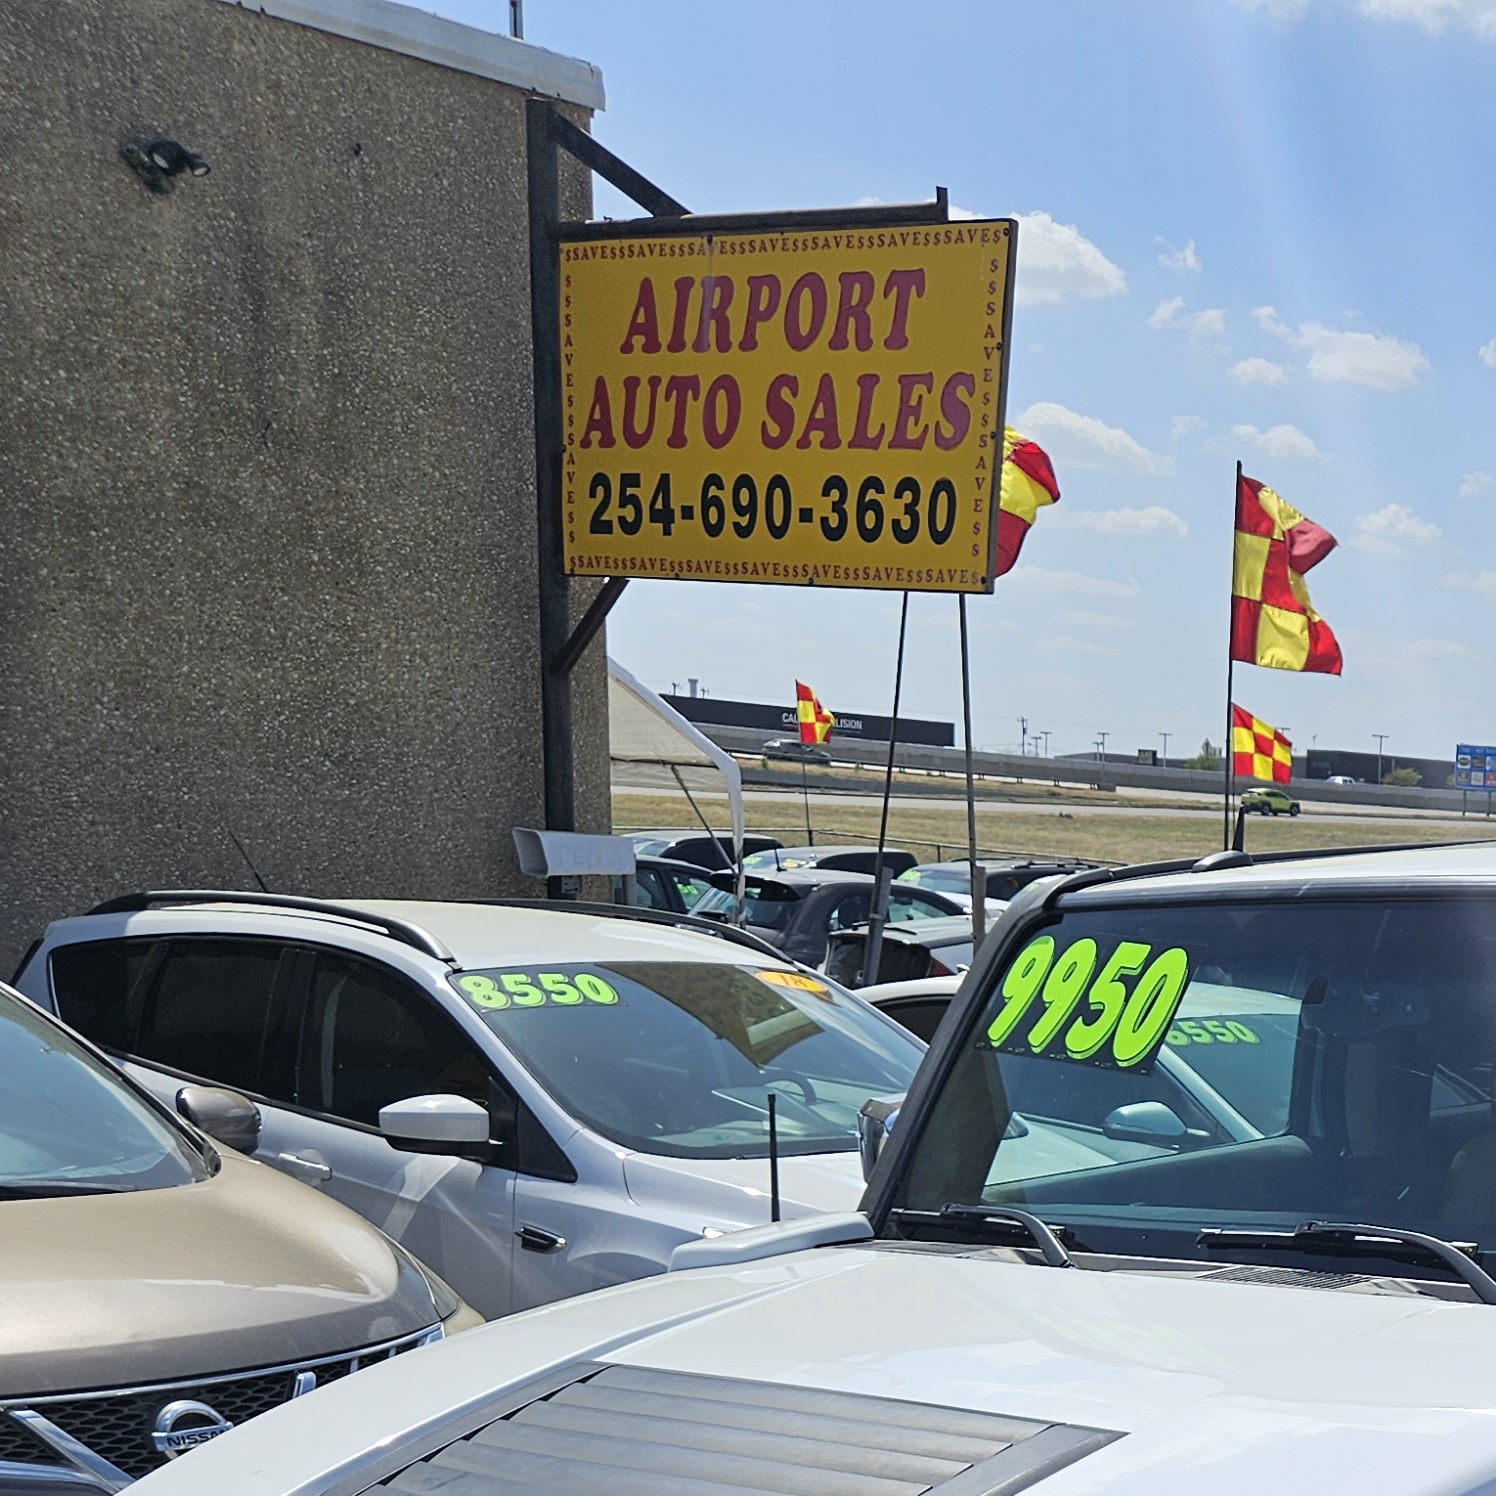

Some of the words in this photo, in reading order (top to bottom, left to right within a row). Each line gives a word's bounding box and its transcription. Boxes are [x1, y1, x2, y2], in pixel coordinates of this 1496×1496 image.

[620, 268, 926, 355] AIRPORT
[580, 374, 742, 450] AUTO
[760, 372, 977, 452] SALES
[588, 472, 957, 545] 254-690-3630
[458, 971, 620, 1010] 8550
[987, 935, 1189, 1068] 9950
[166, 1427, 230, 1448] NISSA
